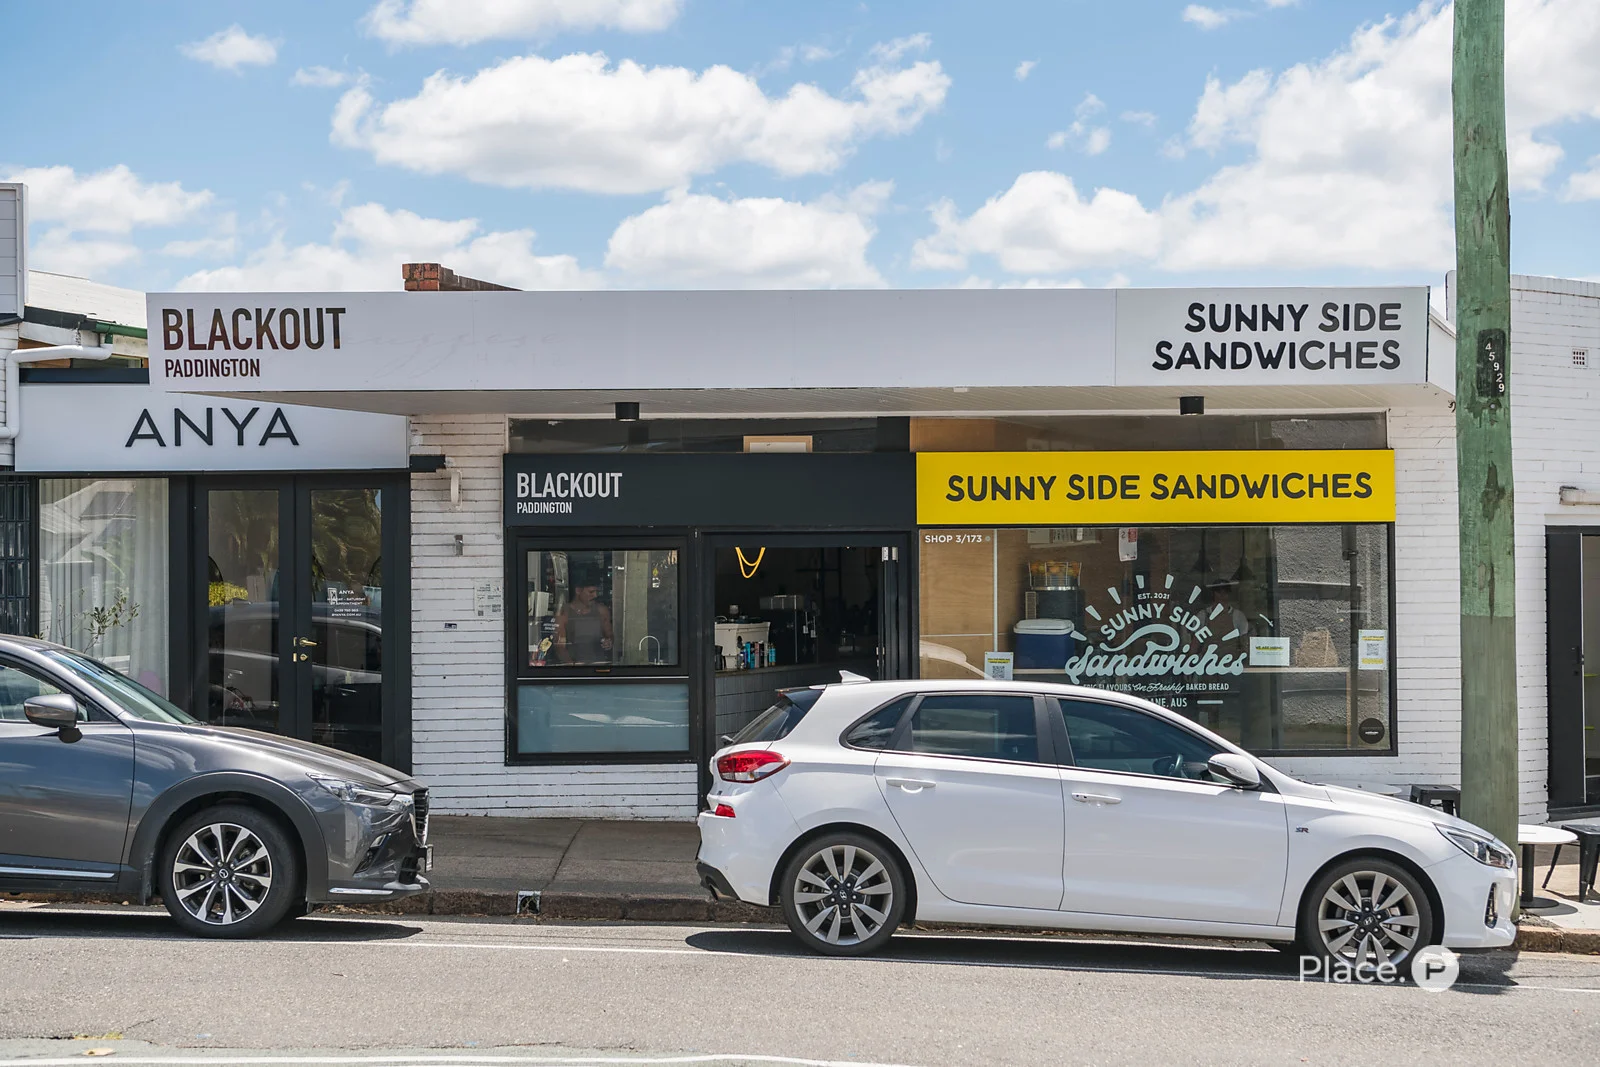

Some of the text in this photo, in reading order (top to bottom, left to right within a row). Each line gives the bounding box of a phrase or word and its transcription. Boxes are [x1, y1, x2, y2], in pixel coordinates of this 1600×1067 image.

[162, 307, 347, 351] BLACKOUT
[1184, 302, 1402, 333] SUNNY SIDE
[164, 358, 261, 378] PADDINGTON
[1151, 339, 1401, 371] SANDWICHES
[1485, 342, 1505, 393] 45929
[124, 406, 300, 448] ANYA
[516, 472, 623, 498] BLACKOUT
[946, 472, 1373, 502] SUNNY SIDE SANDWICHES
[516, 501, 573, 514] PADDINGTON
[924, 534, 983, 544] SHOP 3/173
[1137, 592, 1170, 600] EST. 2021
[1100, 603, 1213, 643] SUNNY SIDE
[1064, 624, 1248, 685] Sandwiches
[1186, 683, 1207, 691] BAKED
[1208, 683, 1230, 691] BREAD
[1170, 697, 1188, 708] AUS
